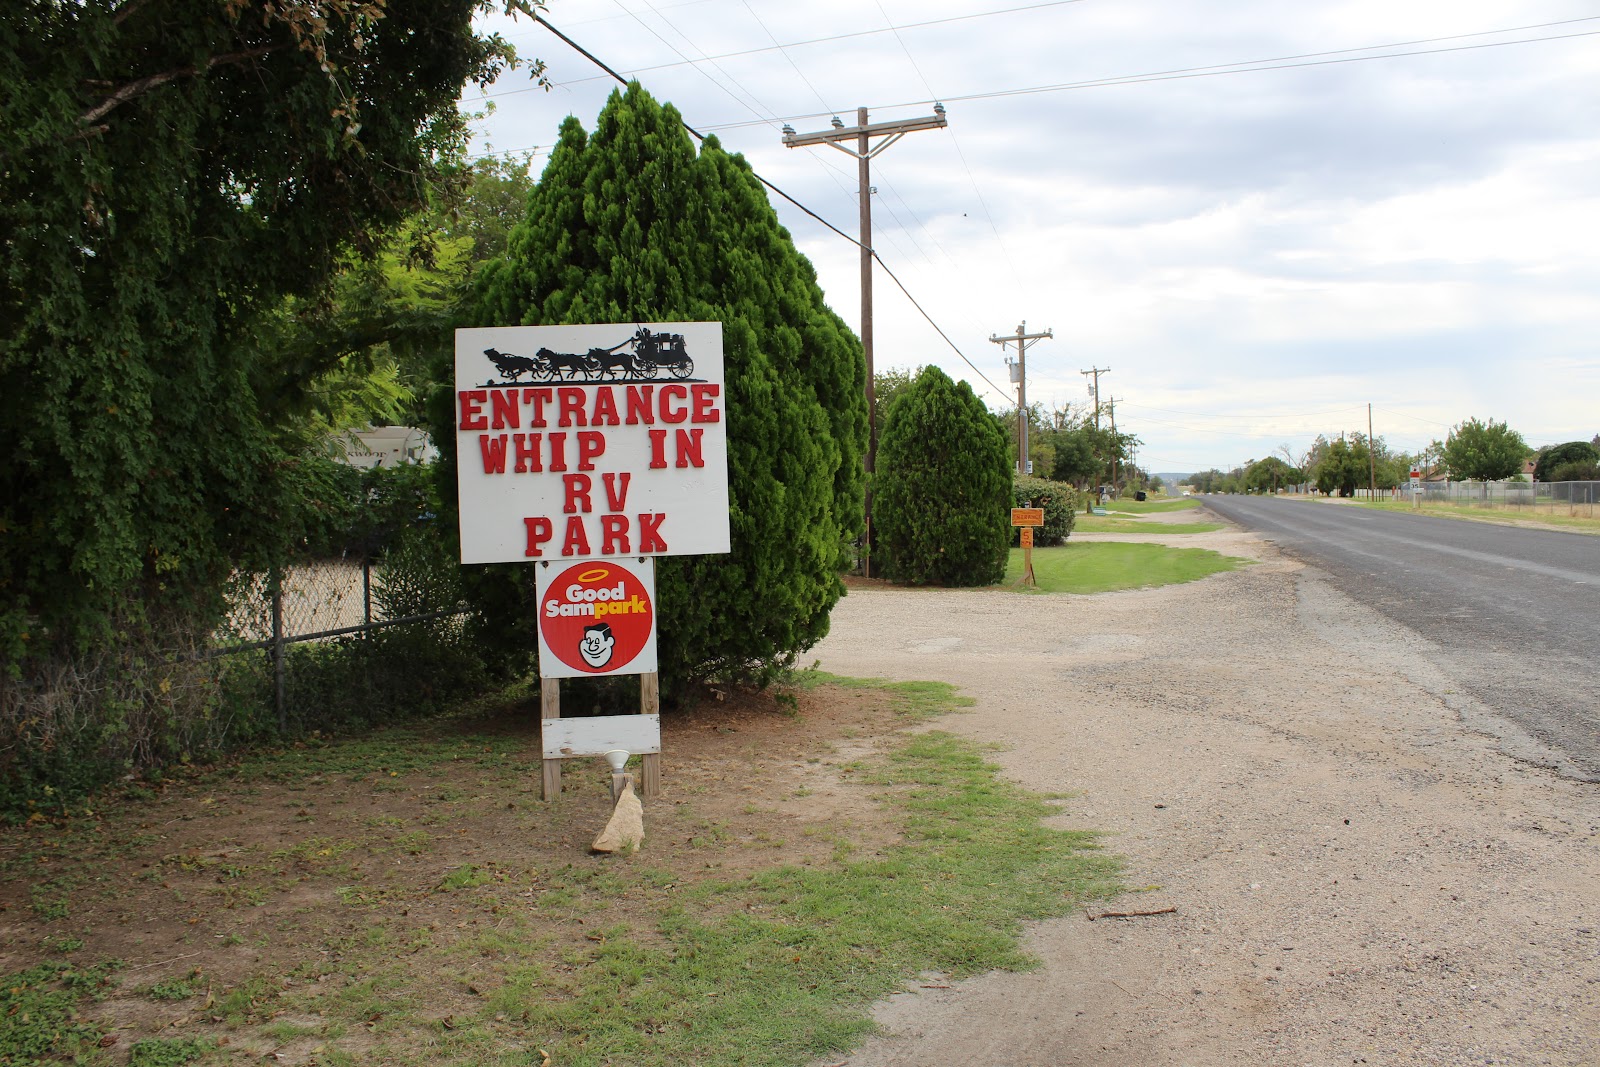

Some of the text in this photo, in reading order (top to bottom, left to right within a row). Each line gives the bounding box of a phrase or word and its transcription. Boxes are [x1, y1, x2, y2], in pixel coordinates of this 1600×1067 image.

[458, 384, 720, 430] ENTRANCE
[479, 428, 705, 474] WHIP IN
[563, 472, 631, 514] RV
[524, 513, 668, 557] PARK
[1023, 531, 1030, 540] 5
[566, 581, 625, 603] Good
